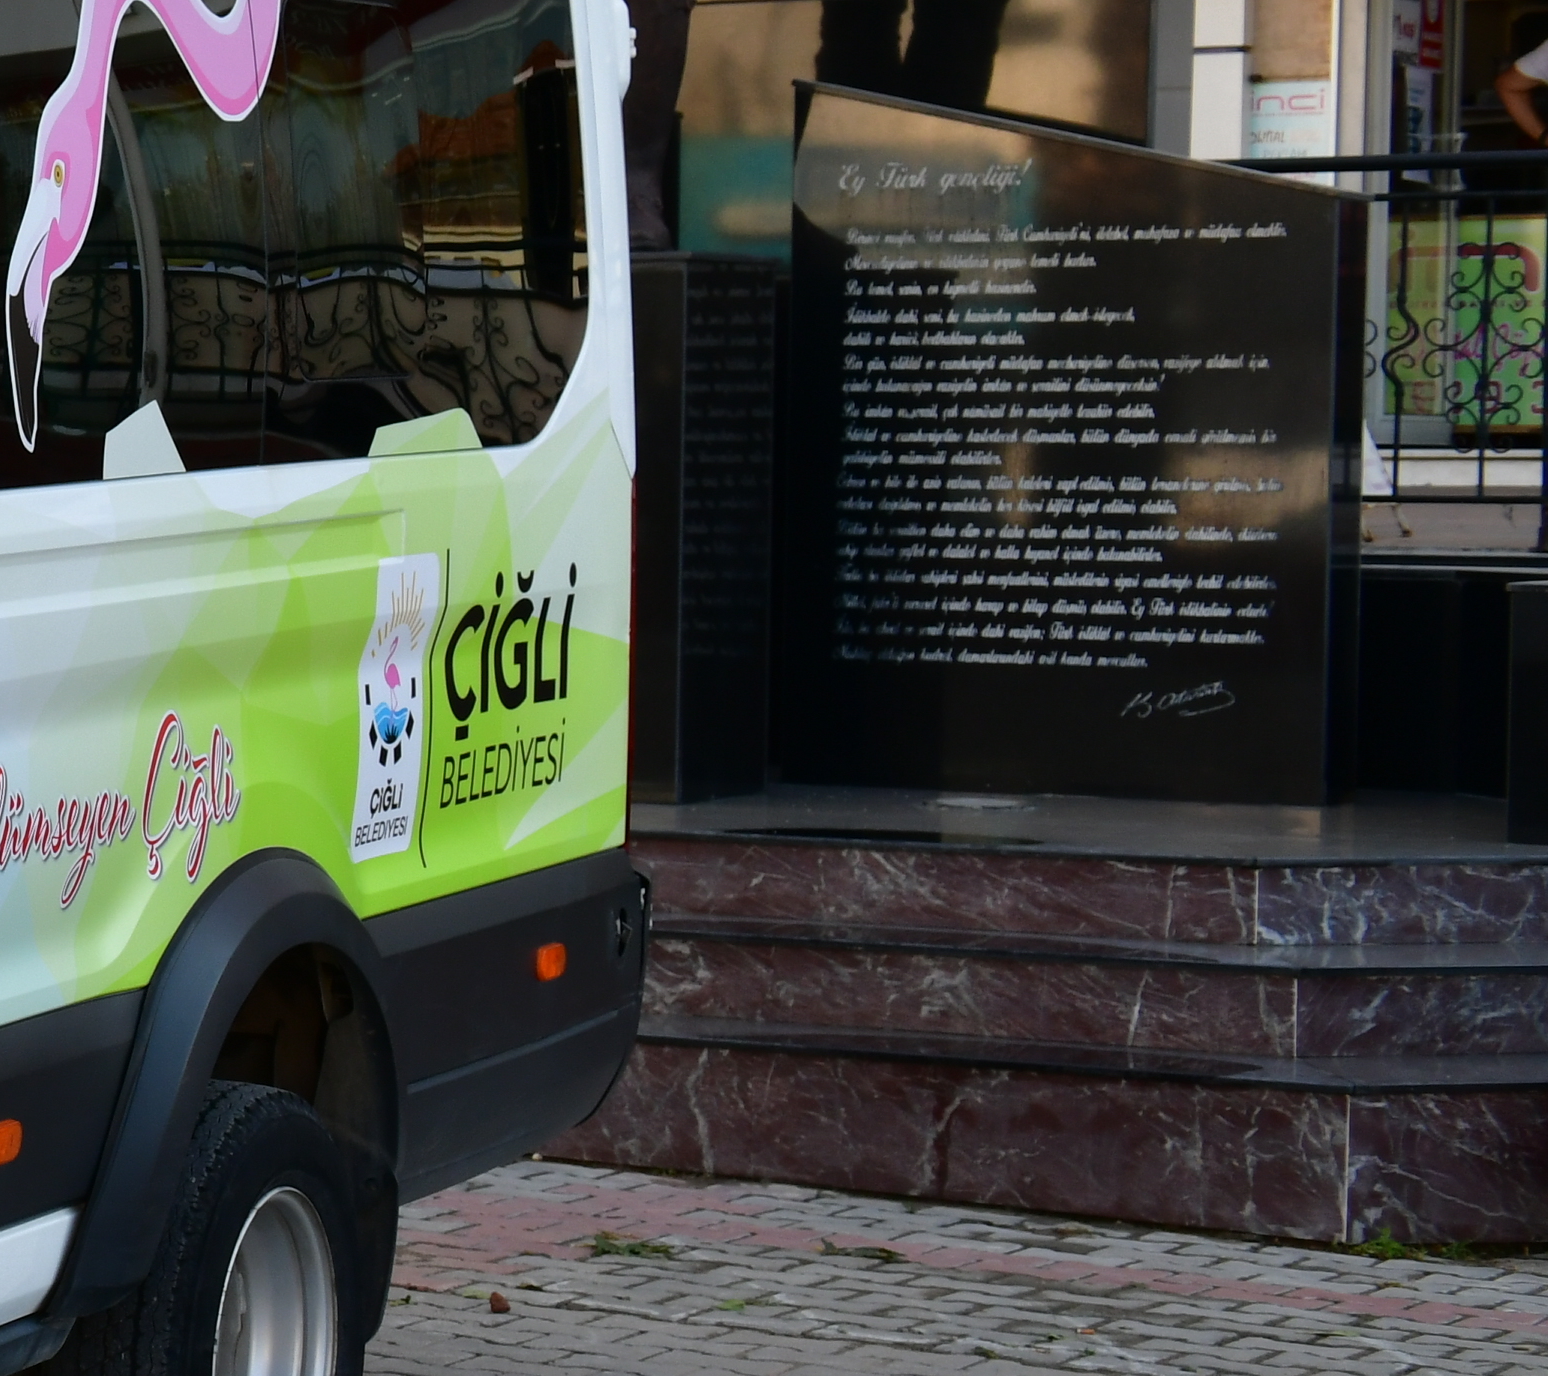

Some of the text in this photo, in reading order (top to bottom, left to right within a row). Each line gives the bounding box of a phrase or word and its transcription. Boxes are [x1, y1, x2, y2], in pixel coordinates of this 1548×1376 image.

[444, 561, 578, 742] ÇİĞLİ
[141, 709, 241, 882] Çiğli
[369, 778, 404, 818] ÇİĞLİ
[439, 717, 566, 809] BELEDİYESİ
